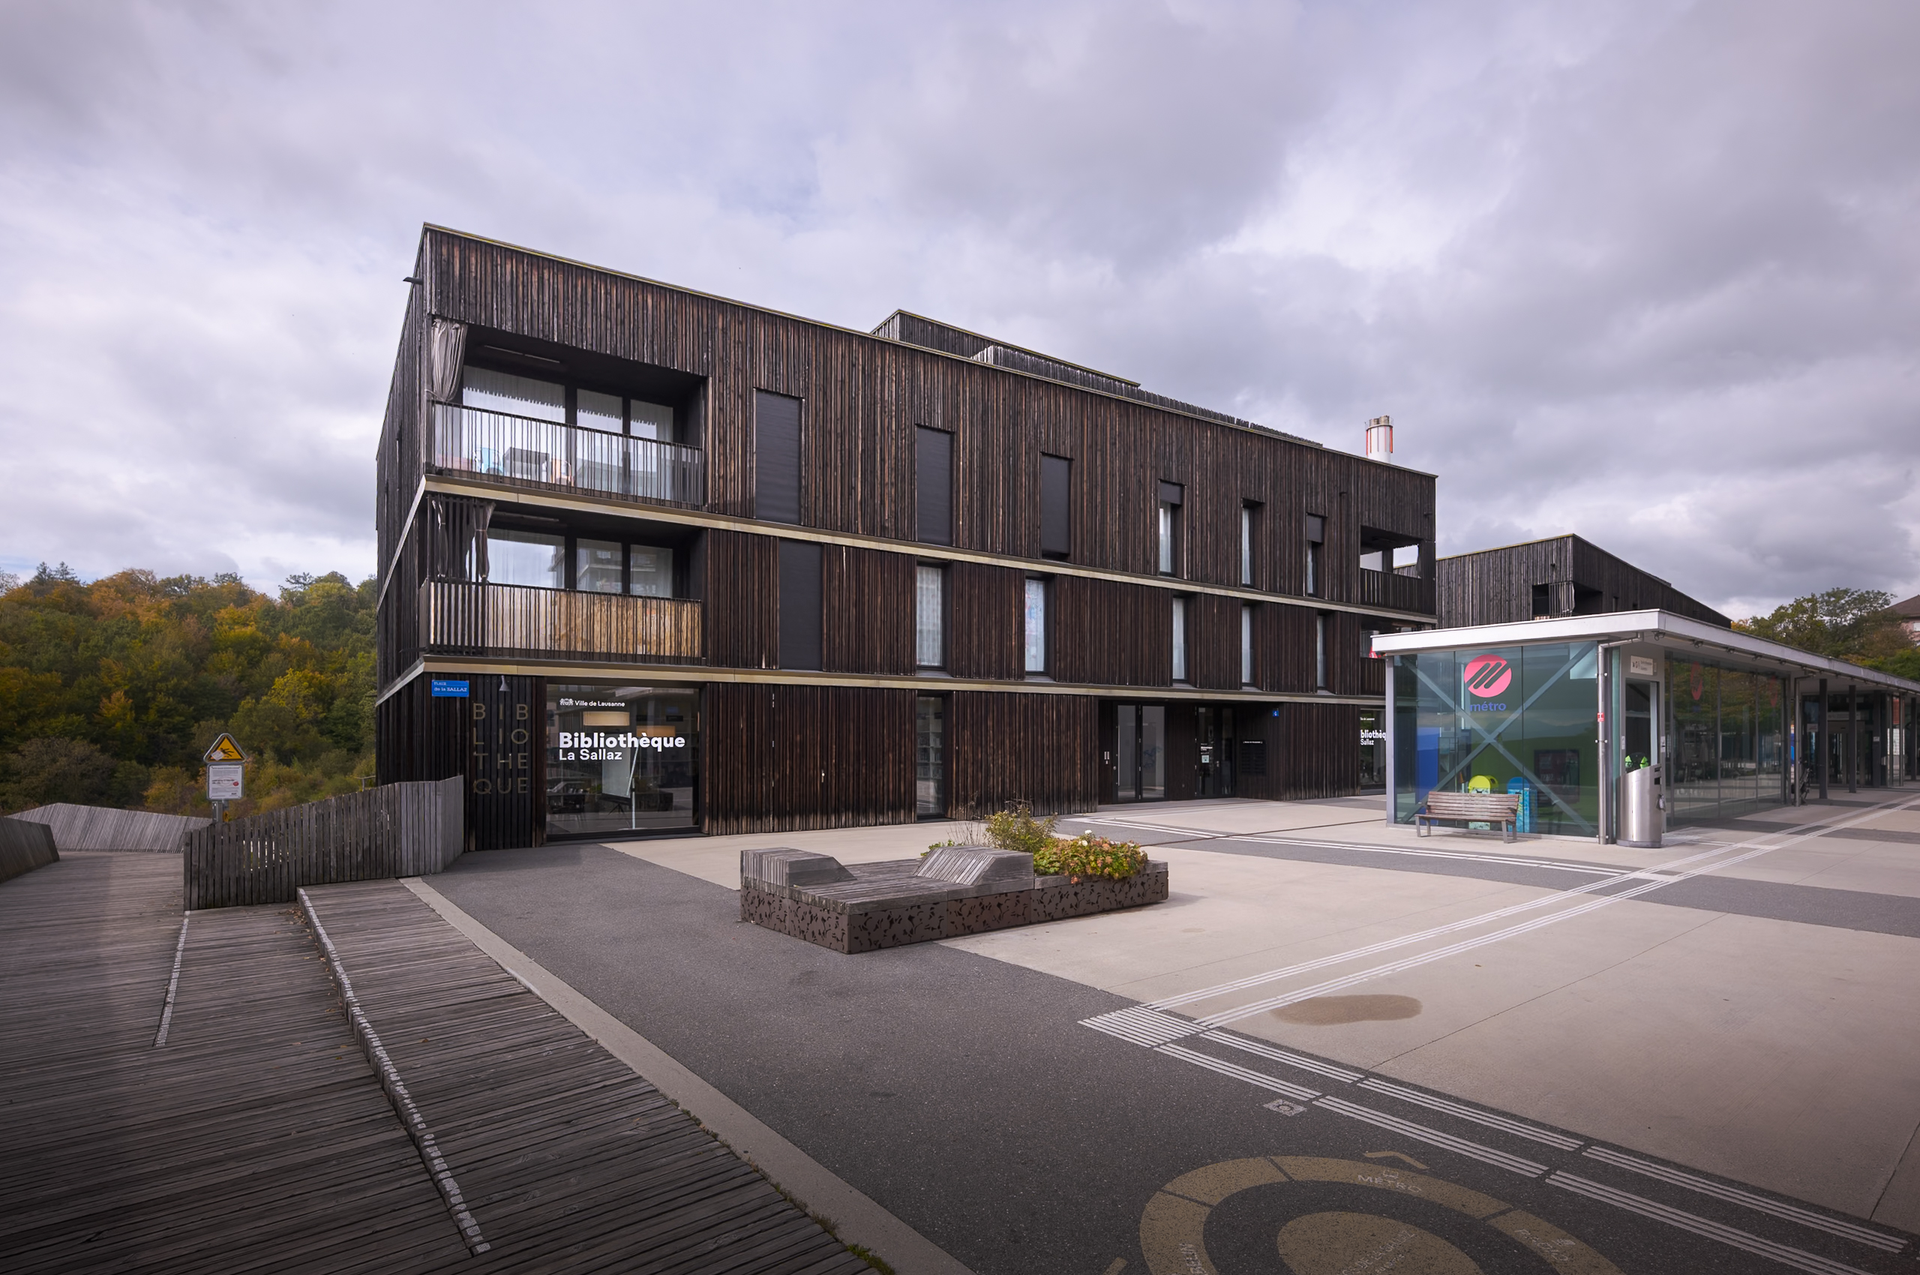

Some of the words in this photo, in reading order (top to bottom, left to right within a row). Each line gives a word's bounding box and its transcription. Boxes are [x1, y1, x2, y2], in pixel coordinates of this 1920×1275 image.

[1469, 701, 1507, 712] métro
[1360, 729, 1387, 741] bliothèq
[559, 732, 686, 752] Bibliothèque
[559, 749, 575, 761] La
[579, 748, 623, 761] Sallaz
